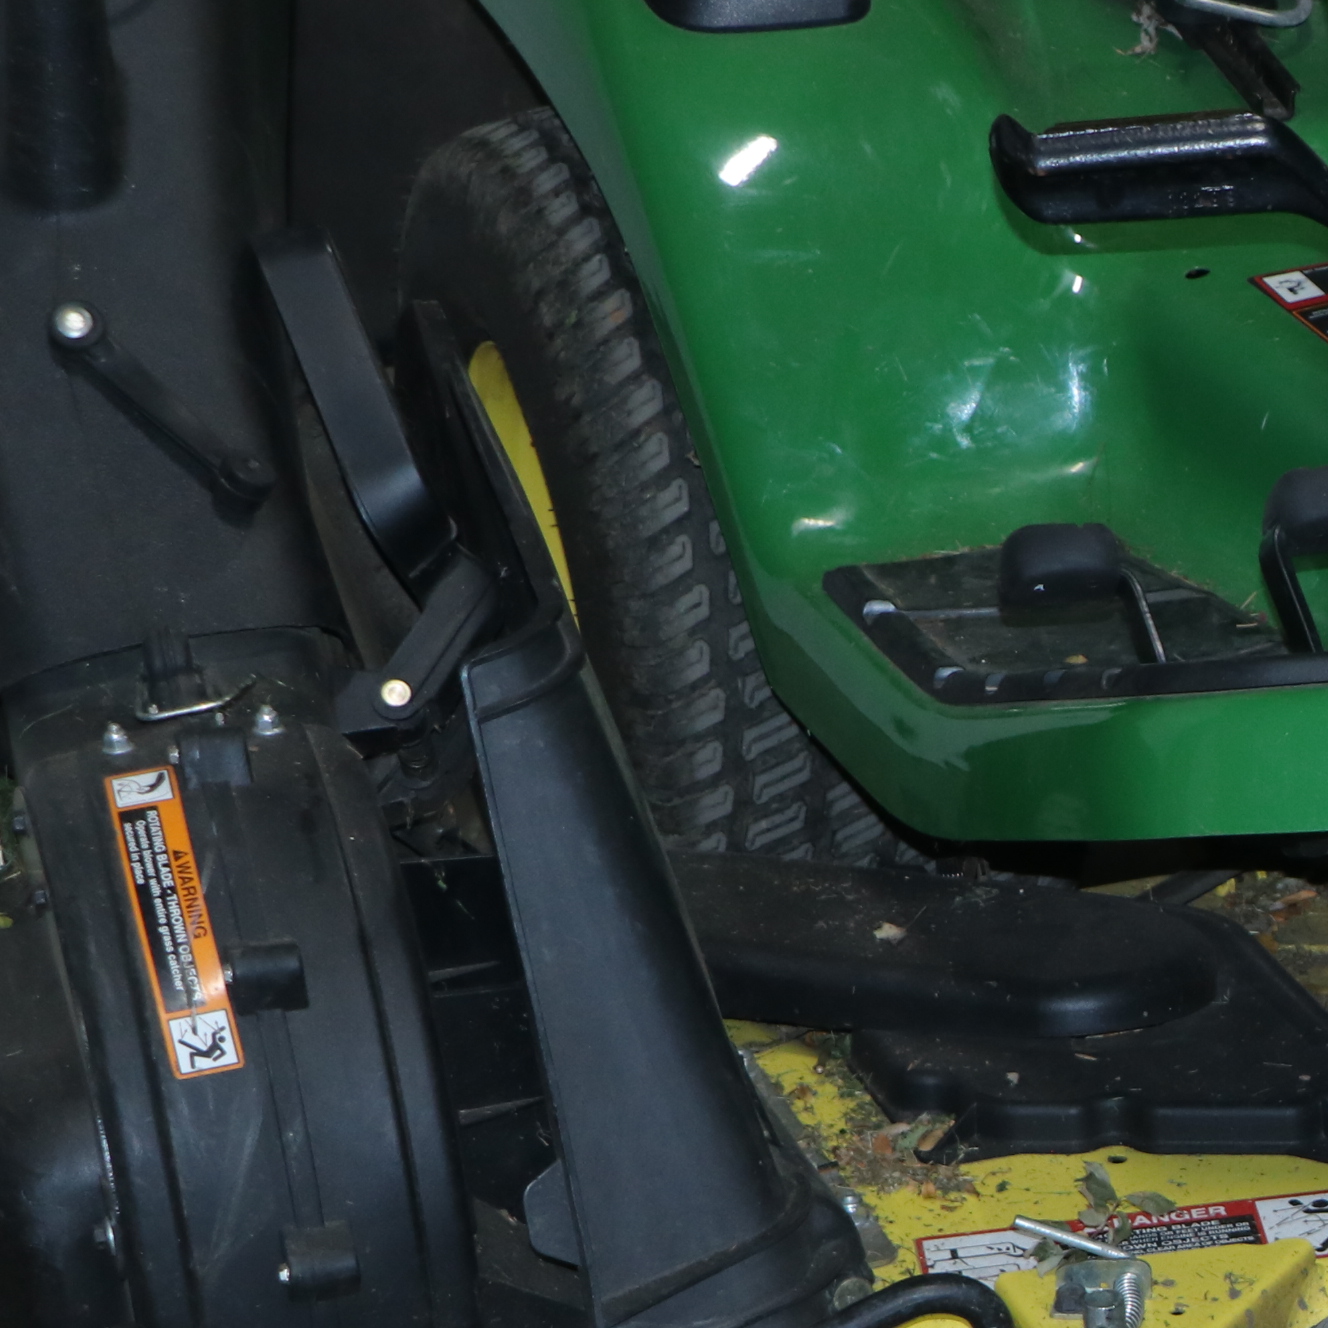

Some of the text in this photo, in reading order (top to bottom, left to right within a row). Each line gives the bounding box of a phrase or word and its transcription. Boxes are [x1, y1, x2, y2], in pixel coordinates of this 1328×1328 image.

[146, 810, 167, 853] ROTATING
[123, 822, 145, 885] secured in place
[155, 854, 175, 888] BLADE
[135, 820, 185, 991] Operate blower with entire grass catcher
[166, 893, 187, 943] THROWN
[175, 861, 208, 939] WARNING
[1161, 1233, 1229, 1246] OBJECTS
[1172, 1220, 1220, 1231] BLADE
[1201, 1222, 1234, 1231] UNDER
[1208, 1226, 1251, 1236] RUNNING
